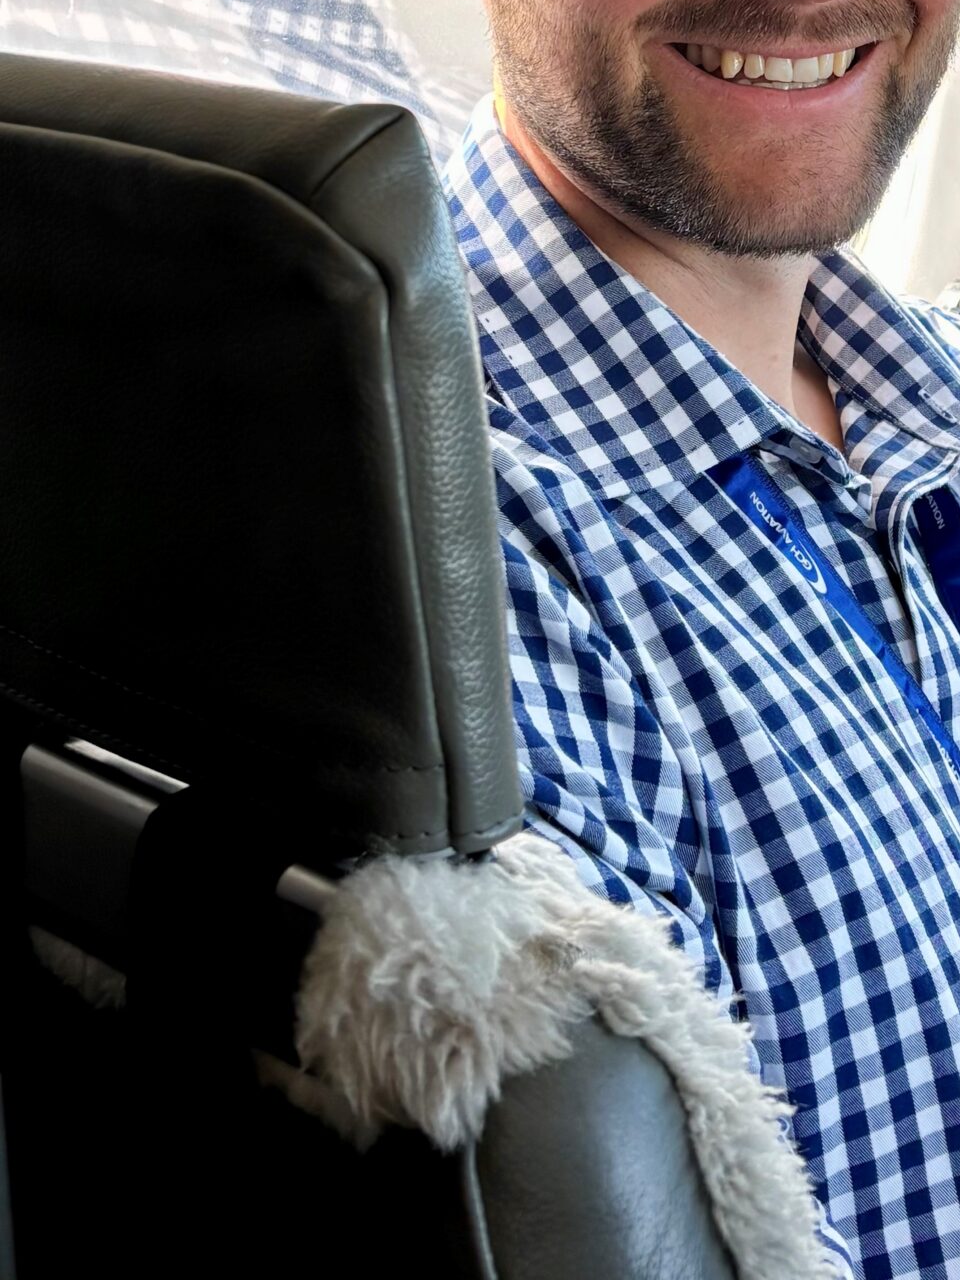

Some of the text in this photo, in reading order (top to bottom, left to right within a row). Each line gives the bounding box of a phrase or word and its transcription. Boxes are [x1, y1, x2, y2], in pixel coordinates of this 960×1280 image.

[749, 491, 812, 571] GCH AVIATION
[925, 494, 945, 530] ATION
